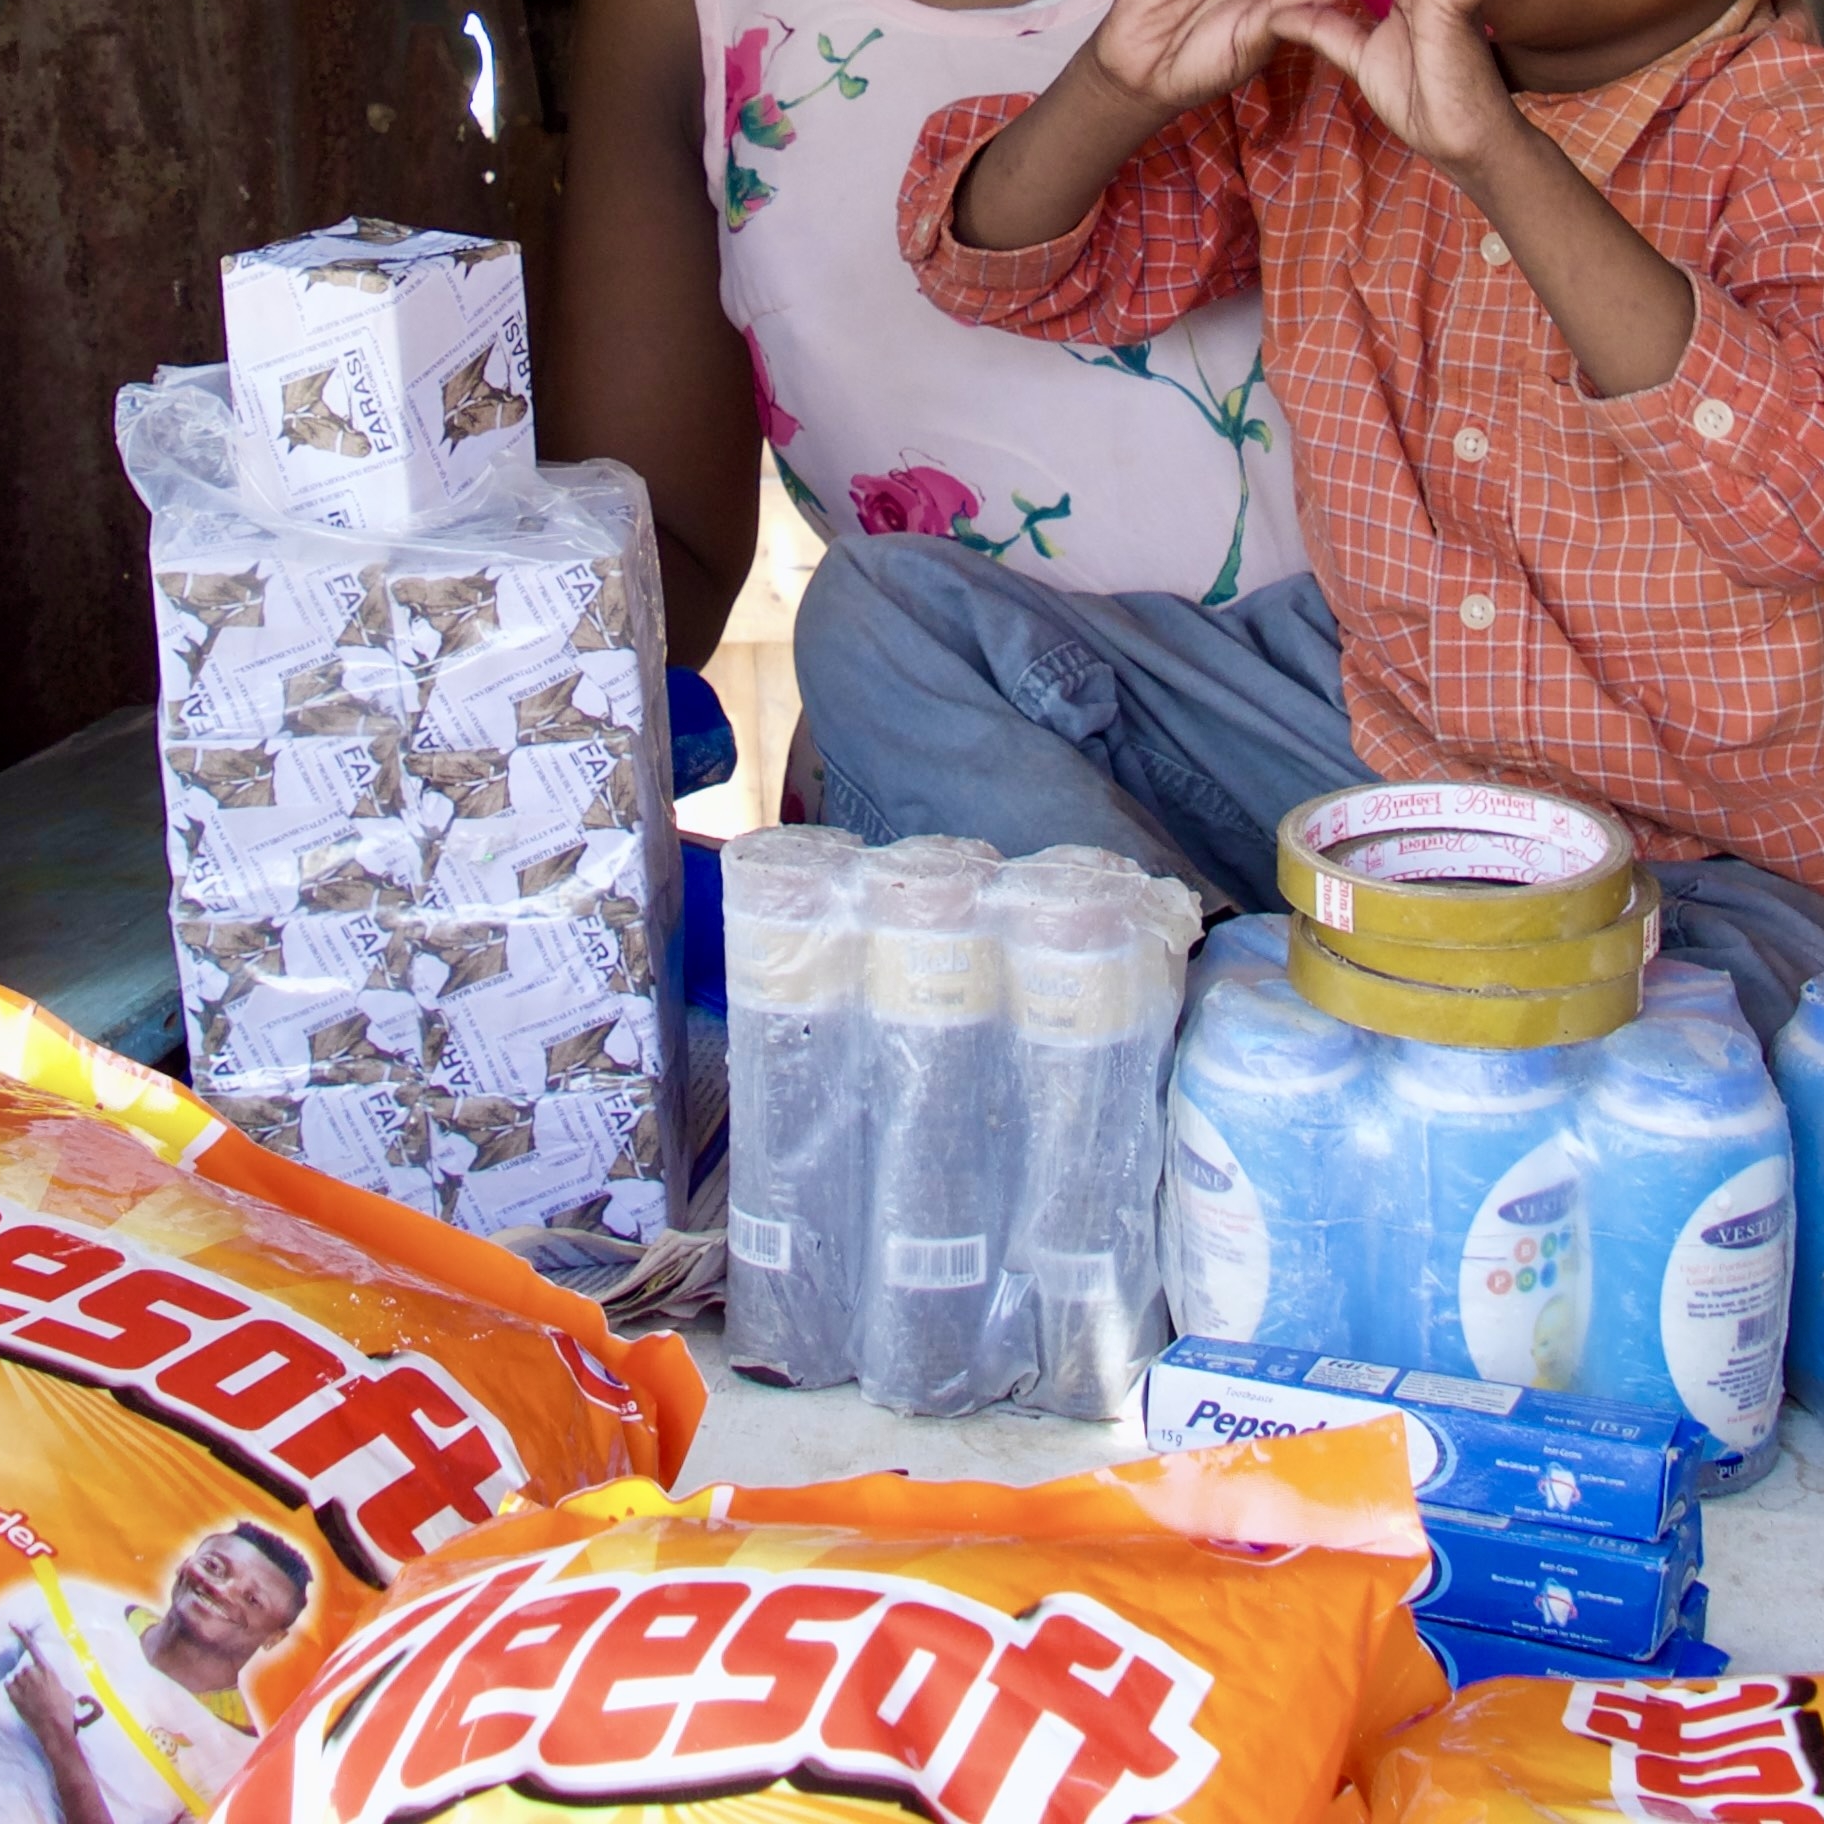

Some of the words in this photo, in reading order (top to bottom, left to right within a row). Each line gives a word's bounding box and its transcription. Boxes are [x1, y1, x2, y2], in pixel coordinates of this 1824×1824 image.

[343, 347, 394, 454] FARASI
[1363, 791, 1444, 826] Budget
[1454, 785, 1537, 821] Budget
